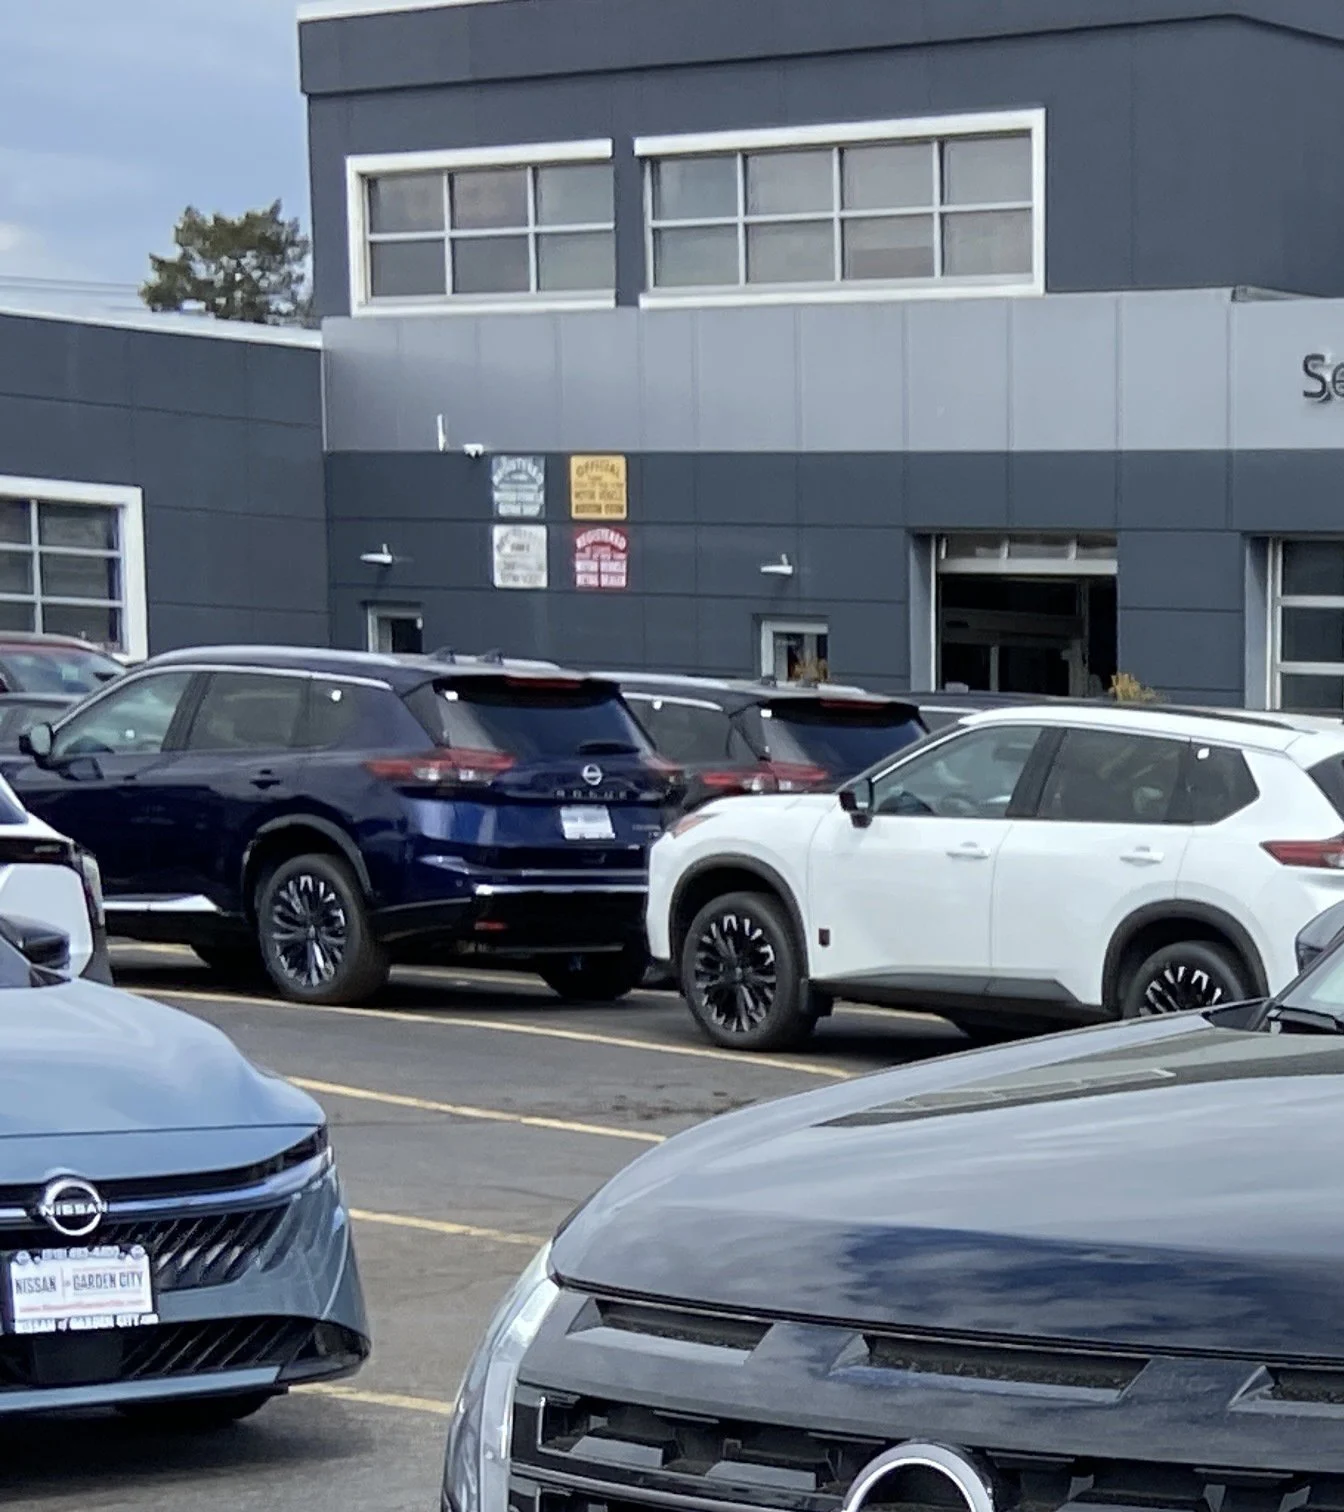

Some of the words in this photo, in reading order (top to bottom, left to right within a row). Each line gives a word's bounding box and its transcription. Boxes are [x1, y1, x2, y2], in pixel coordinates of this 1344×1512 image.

[15, 1275, 57, 1295] NISSAN
[72, 1272, 117, 1291] GARDEN
[119, 1271, 144, 1288] CITY
